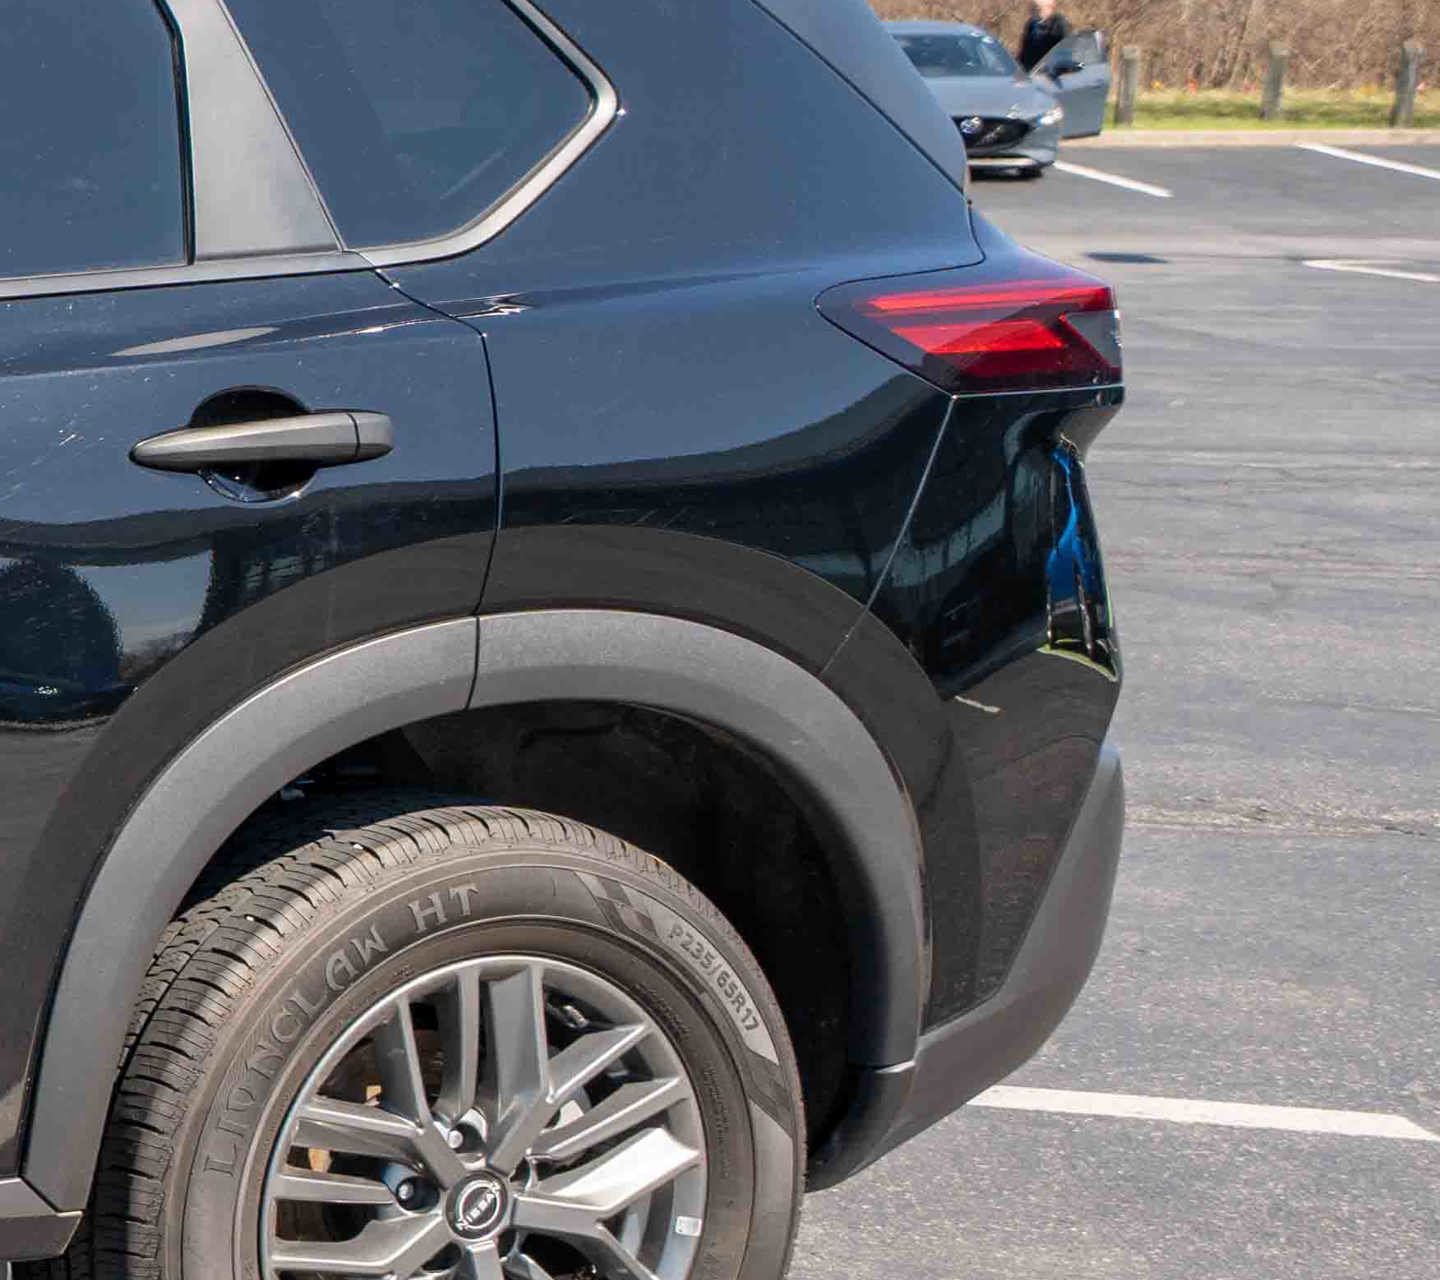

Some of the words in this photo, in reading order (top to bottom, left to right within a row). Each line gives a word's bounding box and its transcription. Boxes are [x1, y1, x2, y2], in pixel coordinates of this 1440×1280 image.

[203, 923, 390, 1178] LIONCLAW
[407, 883, 480, 935] HT
[668, 922, 760, 1037] P235/65R17
[456, 1180, 502, 1231] NISSAN
